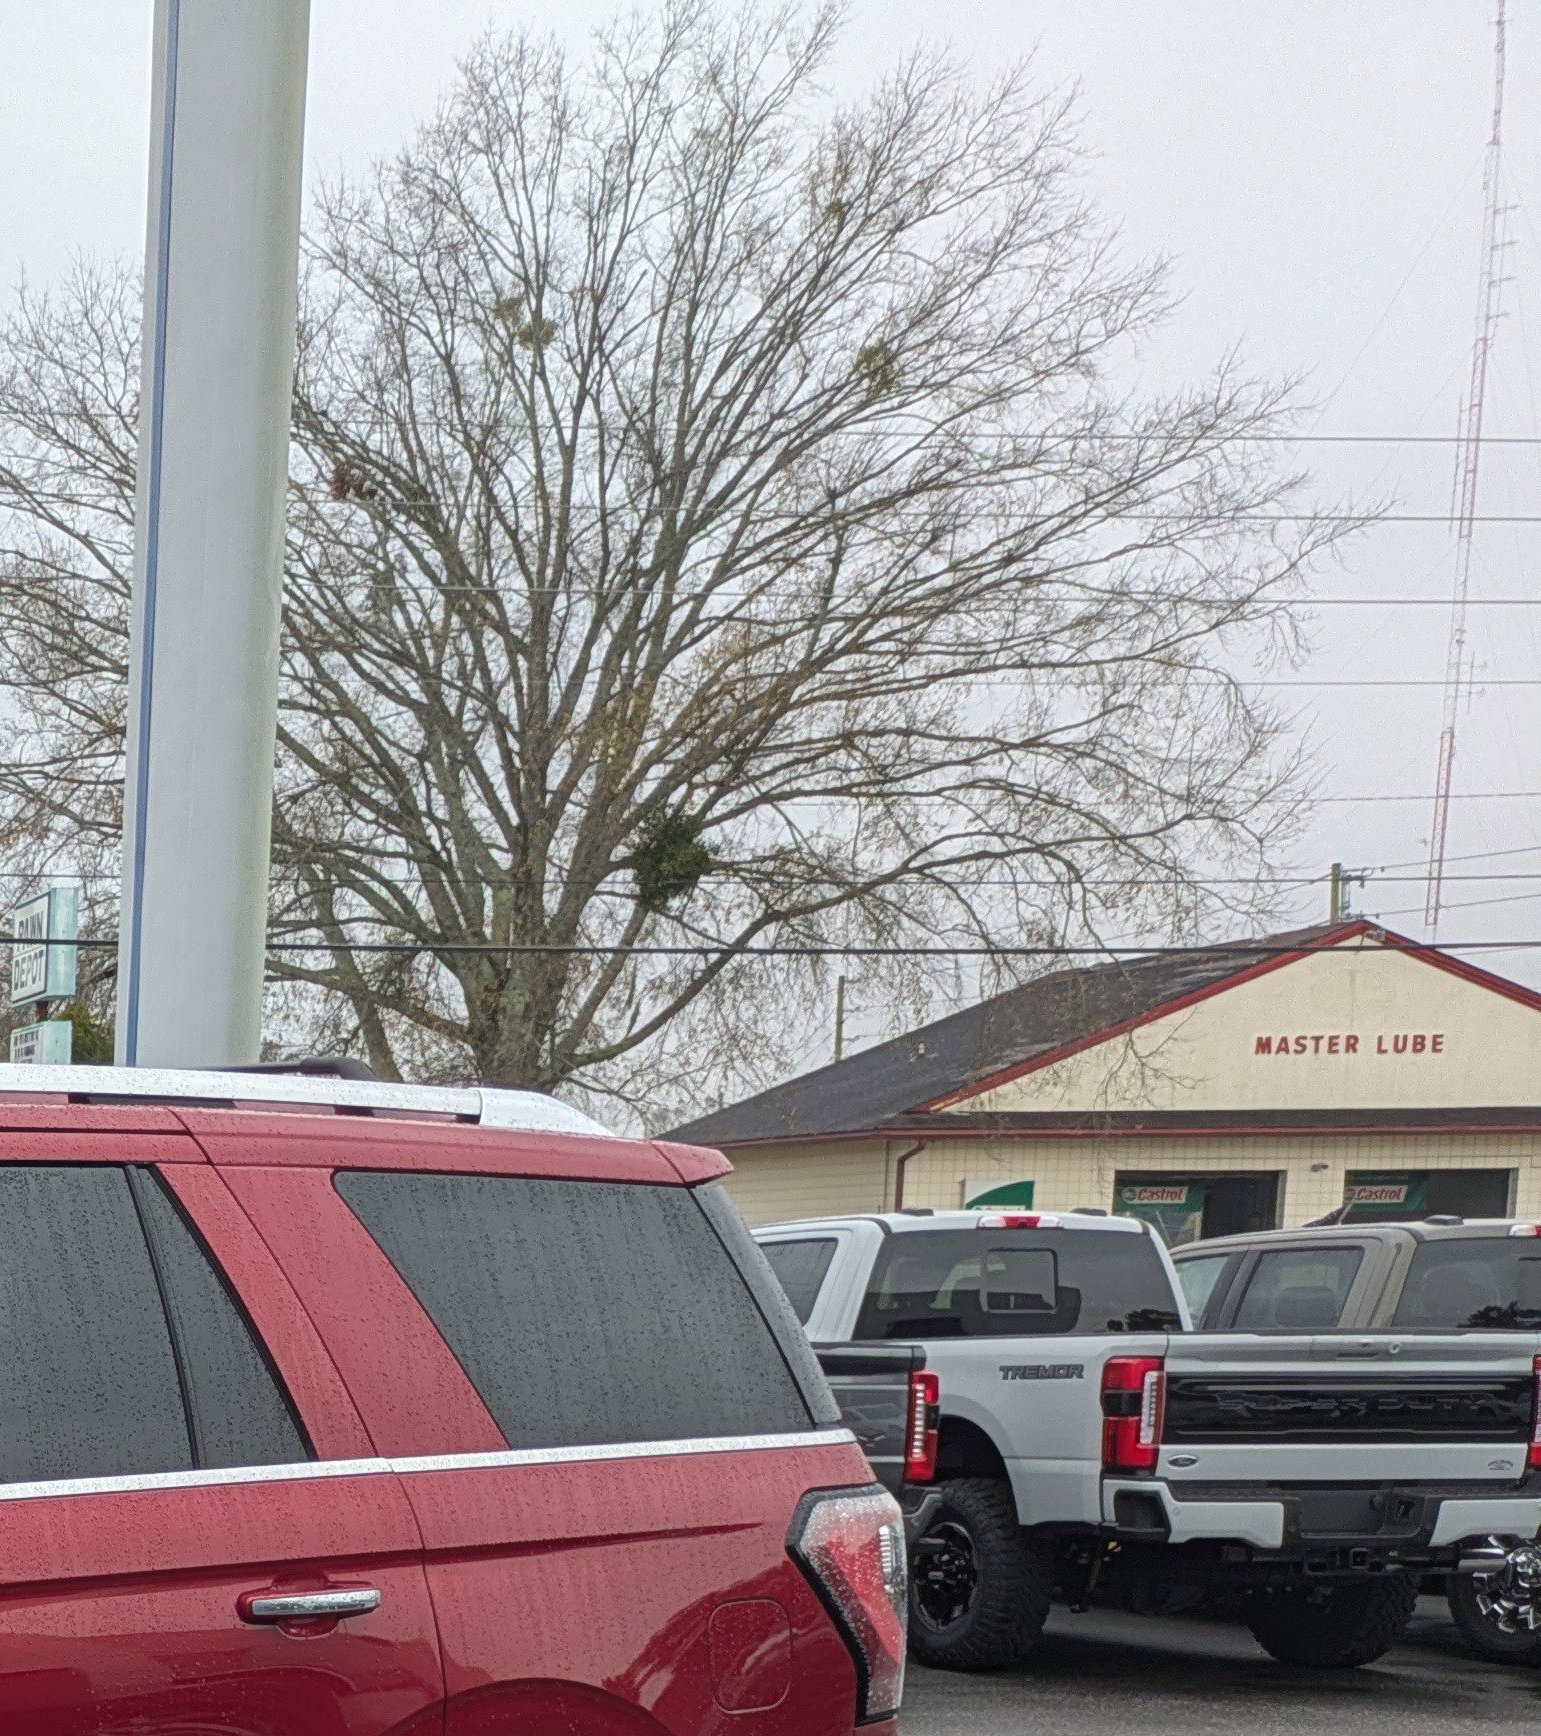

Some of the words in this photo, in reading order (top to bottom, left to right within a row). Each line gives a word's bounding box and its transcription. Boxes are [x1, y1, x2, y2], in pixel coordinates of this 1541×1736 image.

[18, 911, 43, 952] PAWN
[13, 949, 44, 991] DEPOT
[1254, 1034, 1360, 1056] MASTER
[1376, 1033, 1445, 1055] LUBE
[1138, 1188, 1184, 1201] Castrol
[1357, 1187, 1403, 1201] Castrol
[999, 1364, 1085, 1380] TREMOR
